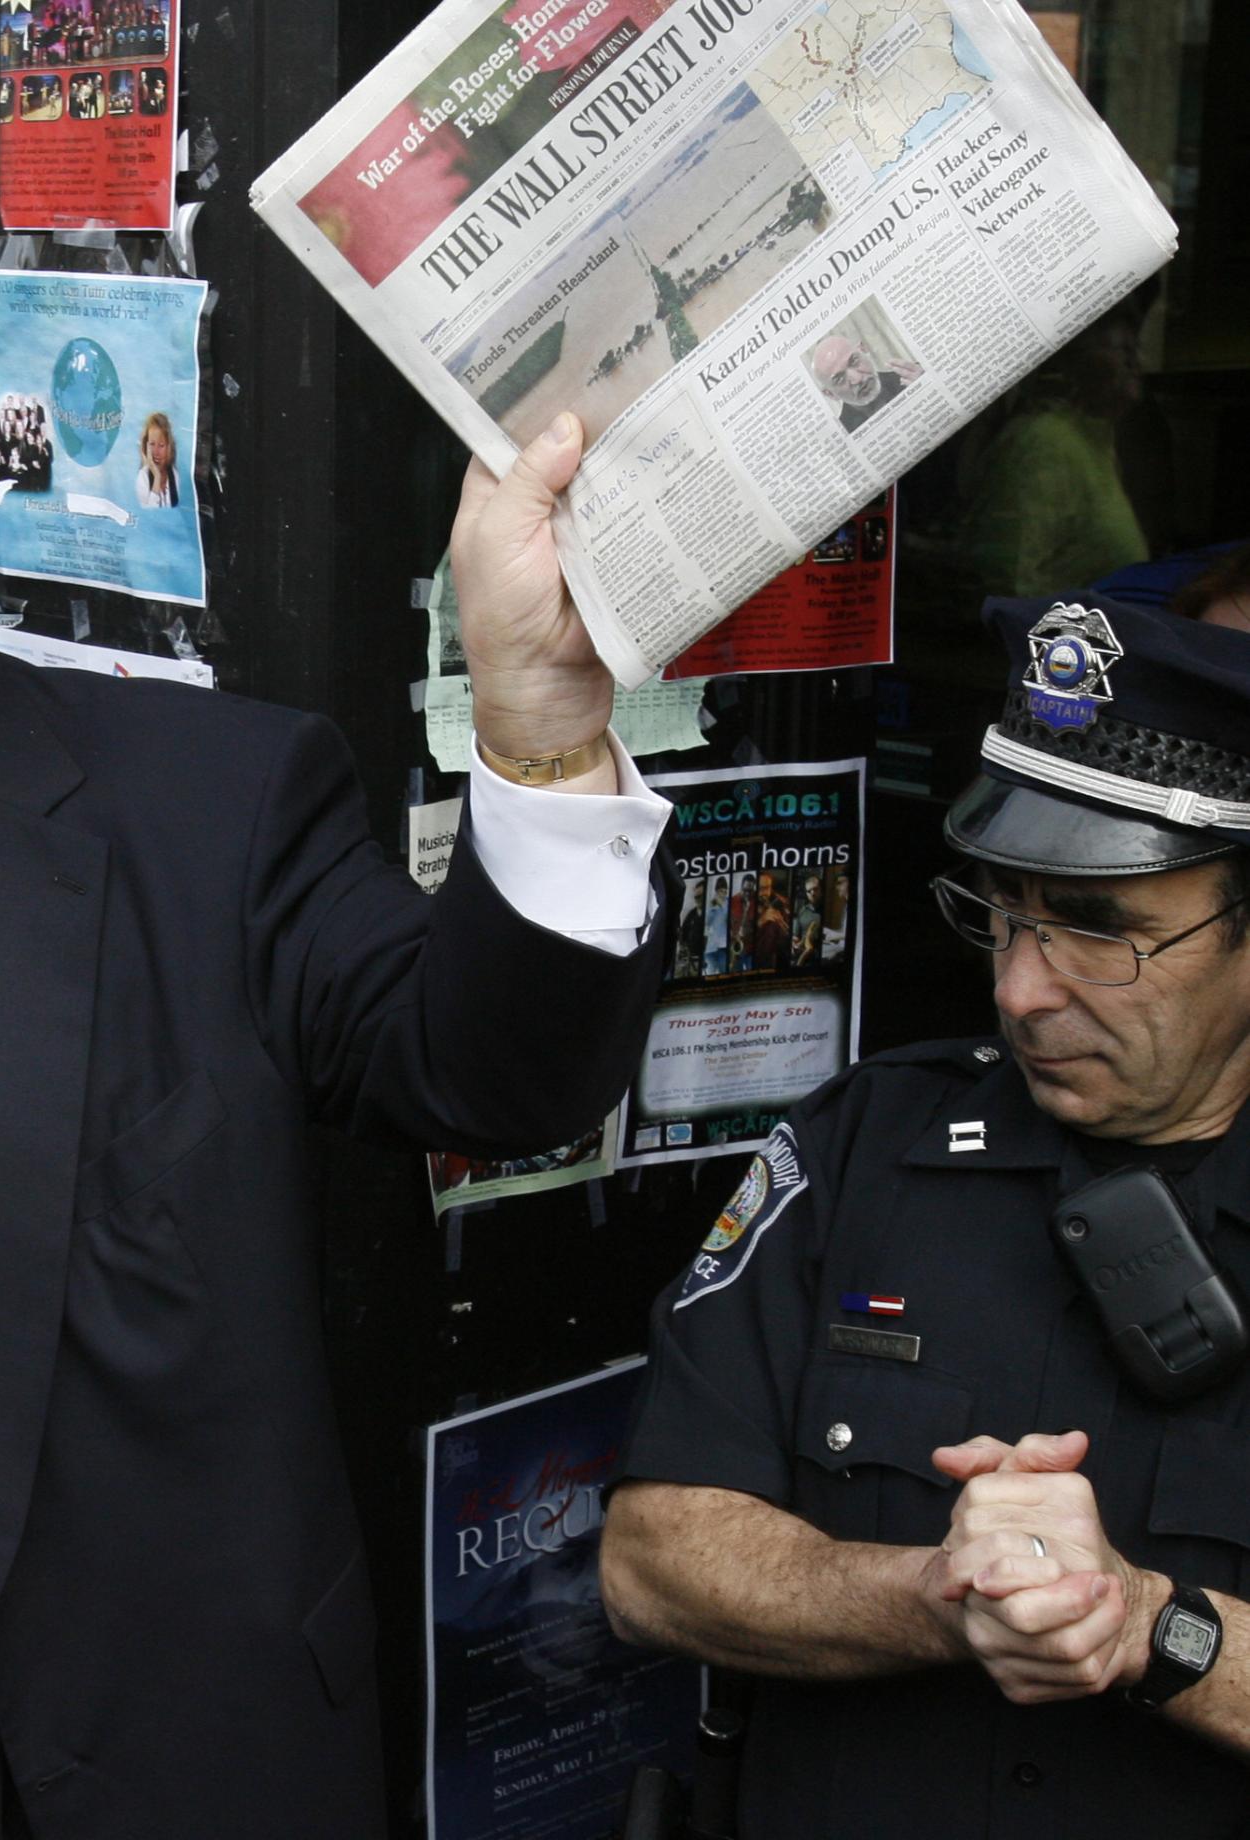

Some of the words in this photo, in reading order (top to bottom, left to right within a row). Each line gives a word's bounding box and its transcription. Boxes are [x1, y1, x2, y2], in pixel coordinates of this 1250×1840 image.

[356, 147, 402, 189] War
[402, 122, 425, 152] of
[419, 98, 457, 132] the
[448, 38, 519, 103] Roses:
[510, 0, 566, 43] Hom
[453, 83, 513, 138] Fight
[506, 55, 540, 90] for
[547, 63, 596, 108] PERSONAL
[419, 211, 503, 292] THE
[483, 140, 586, 228] WALL
[569, 24, 697, 157] STREET
[685, 0, 761, 50] JOU
[612, 144, 632, 164] APRIL
[935, 121, 1001, 179] Hackers
[948, 158, 990, 199] Raid
[987, 129, 1027, 168] Sony
[961, 144, 1048, 228] Videogame
[975, 182, 1046, 242] Network
[457, 343, 506, 384] Floods
[501, 293, 562, 344] Threaten
[556, 236, 620, 296] Heartland
[697, 324, 768, 393] Karzai
[761, 283, 812, 333] Told
[807, 273, 832, 296] to
[827, 216, 895, 278] Dump
[888, 177, 939, 219] U.S.
[712, 379, 748, 412] Pakistan
[771, 317, 820, 363] Afghanistan
[819, 309, 829, 320] to
[830, 293, 847, 312] Ally
[846, 272, 870, 294] With
[868, 232, 917, 277] Islamabad,
[916, 207, 950, 236] Beijing
[576, 475, 638, 521] What's
[637, 432, 678, 470] News
[1031, 698, 1090, 723] CAPTAIN
[676, 797, 755, 828] WSCA
[762, 792, 840, 818] 106.1
[417, 831, 456, 854] Musicia
[675, 850, 748, 878] oston
[761, 843, 850, 868] horns
[668, 1013, 740, 1031] Thursday
[745, 1009, 779, 1024] May
[784, 1006, 814, 1018] 5th
[706, 1025, 740, 1039] 7:30
[744, 1023, 771, 1036] pm
[802, 1031, 829, 1043] Concert
[764, 1136, 801, 1190] MOUTH
[455, 1484, 605, 1578] REQU
[494, 1735, 545, 1764] FRIDAY,
[549, 1720, 588, 1745] APRIL
[590, 1709, 607, 1727] 29
[493, 1774, 548, 1800] SUNDAY,
[552, 1758, 584, 1778] MAY
